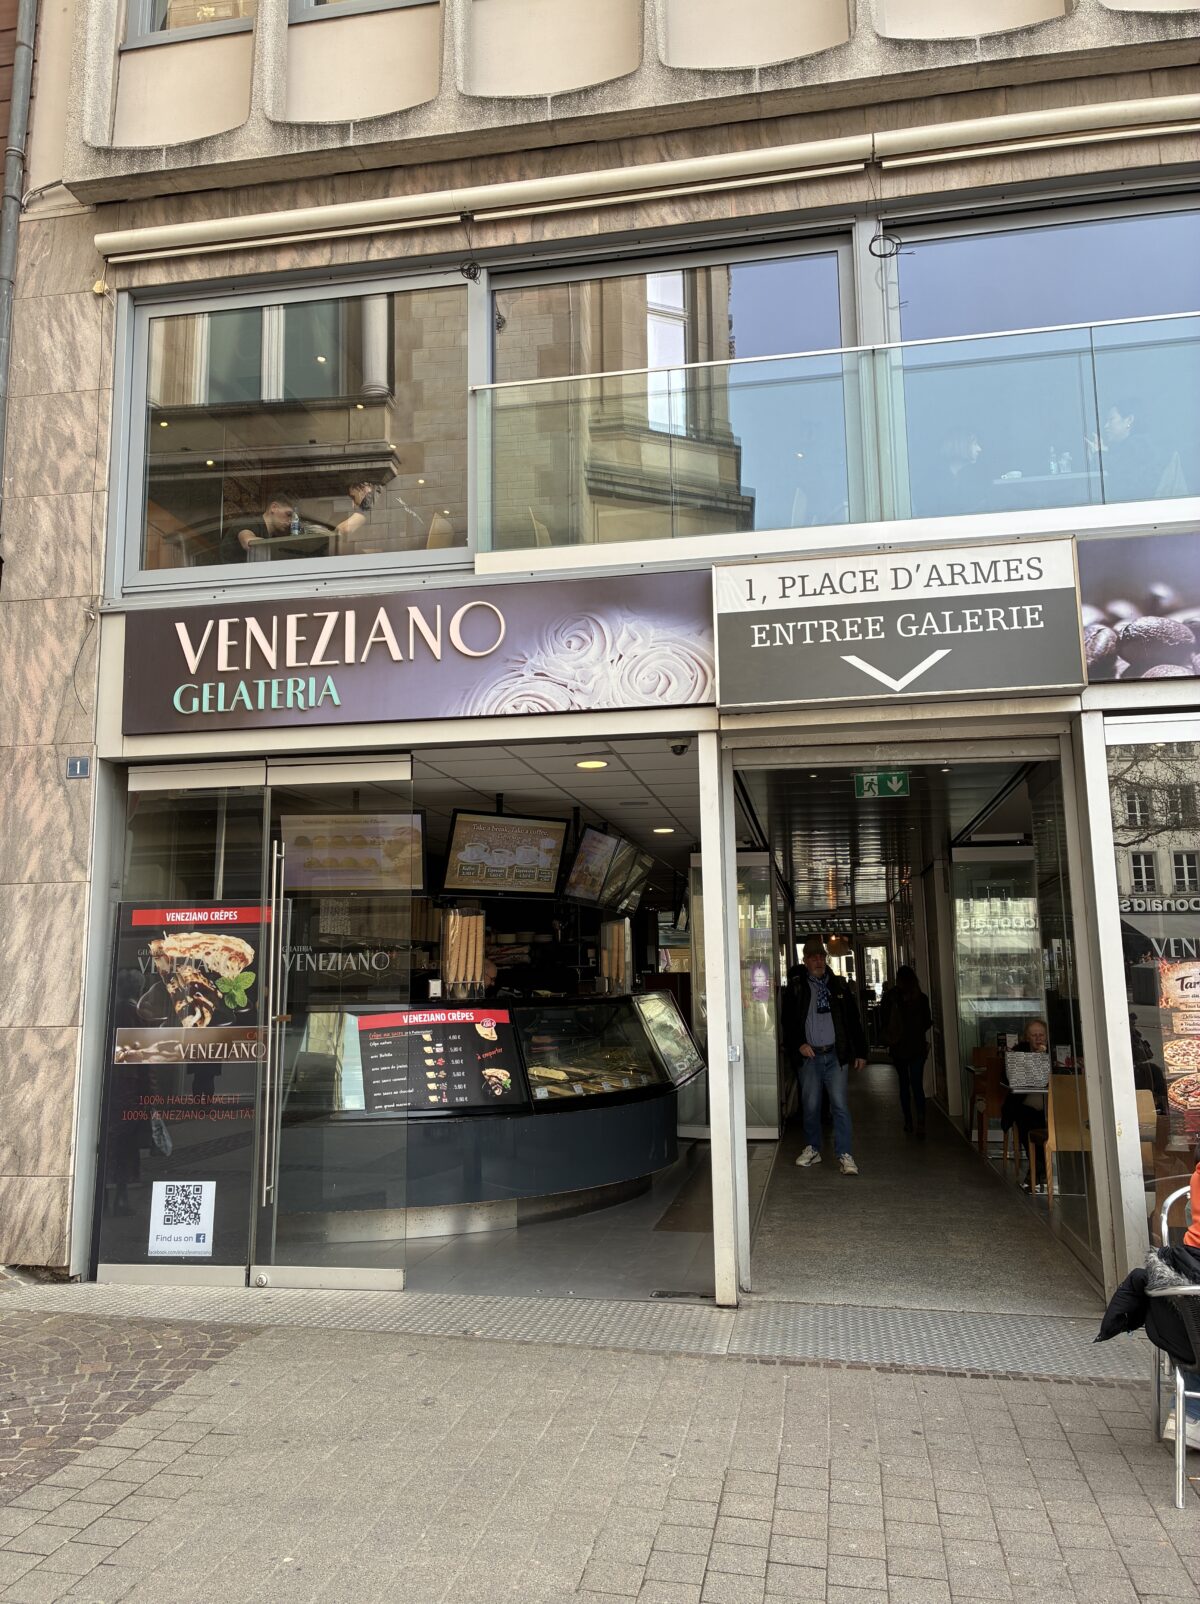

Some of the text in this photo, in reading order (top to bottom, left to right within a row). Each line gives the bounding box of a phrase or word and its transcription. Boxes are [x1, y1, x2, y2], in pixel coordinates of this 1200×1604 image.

[745, 556, 1044, 605] 1, PLACE D'ARMES
[750, 605, 1044, 648] ENTREE GALERIE
[175, 601, 506, 675] VENEZIANO
[173, 675, 342, 715] GELATERIA
[166, 910, 238, 922] VENEZIANO CRÊPES
[282, 952, 390, 972] VENEZIANO
[402, 1010, 474, 1024] VENEZIANO CRÊPES
[178, 1042, 266, 1059] VENEZIANO
[139, 1094, 240, 1105] 100% HAUSGEMACHT
[122, 1110, 148, 1120] 100%
[156, 1234, 172, 1242] Find
